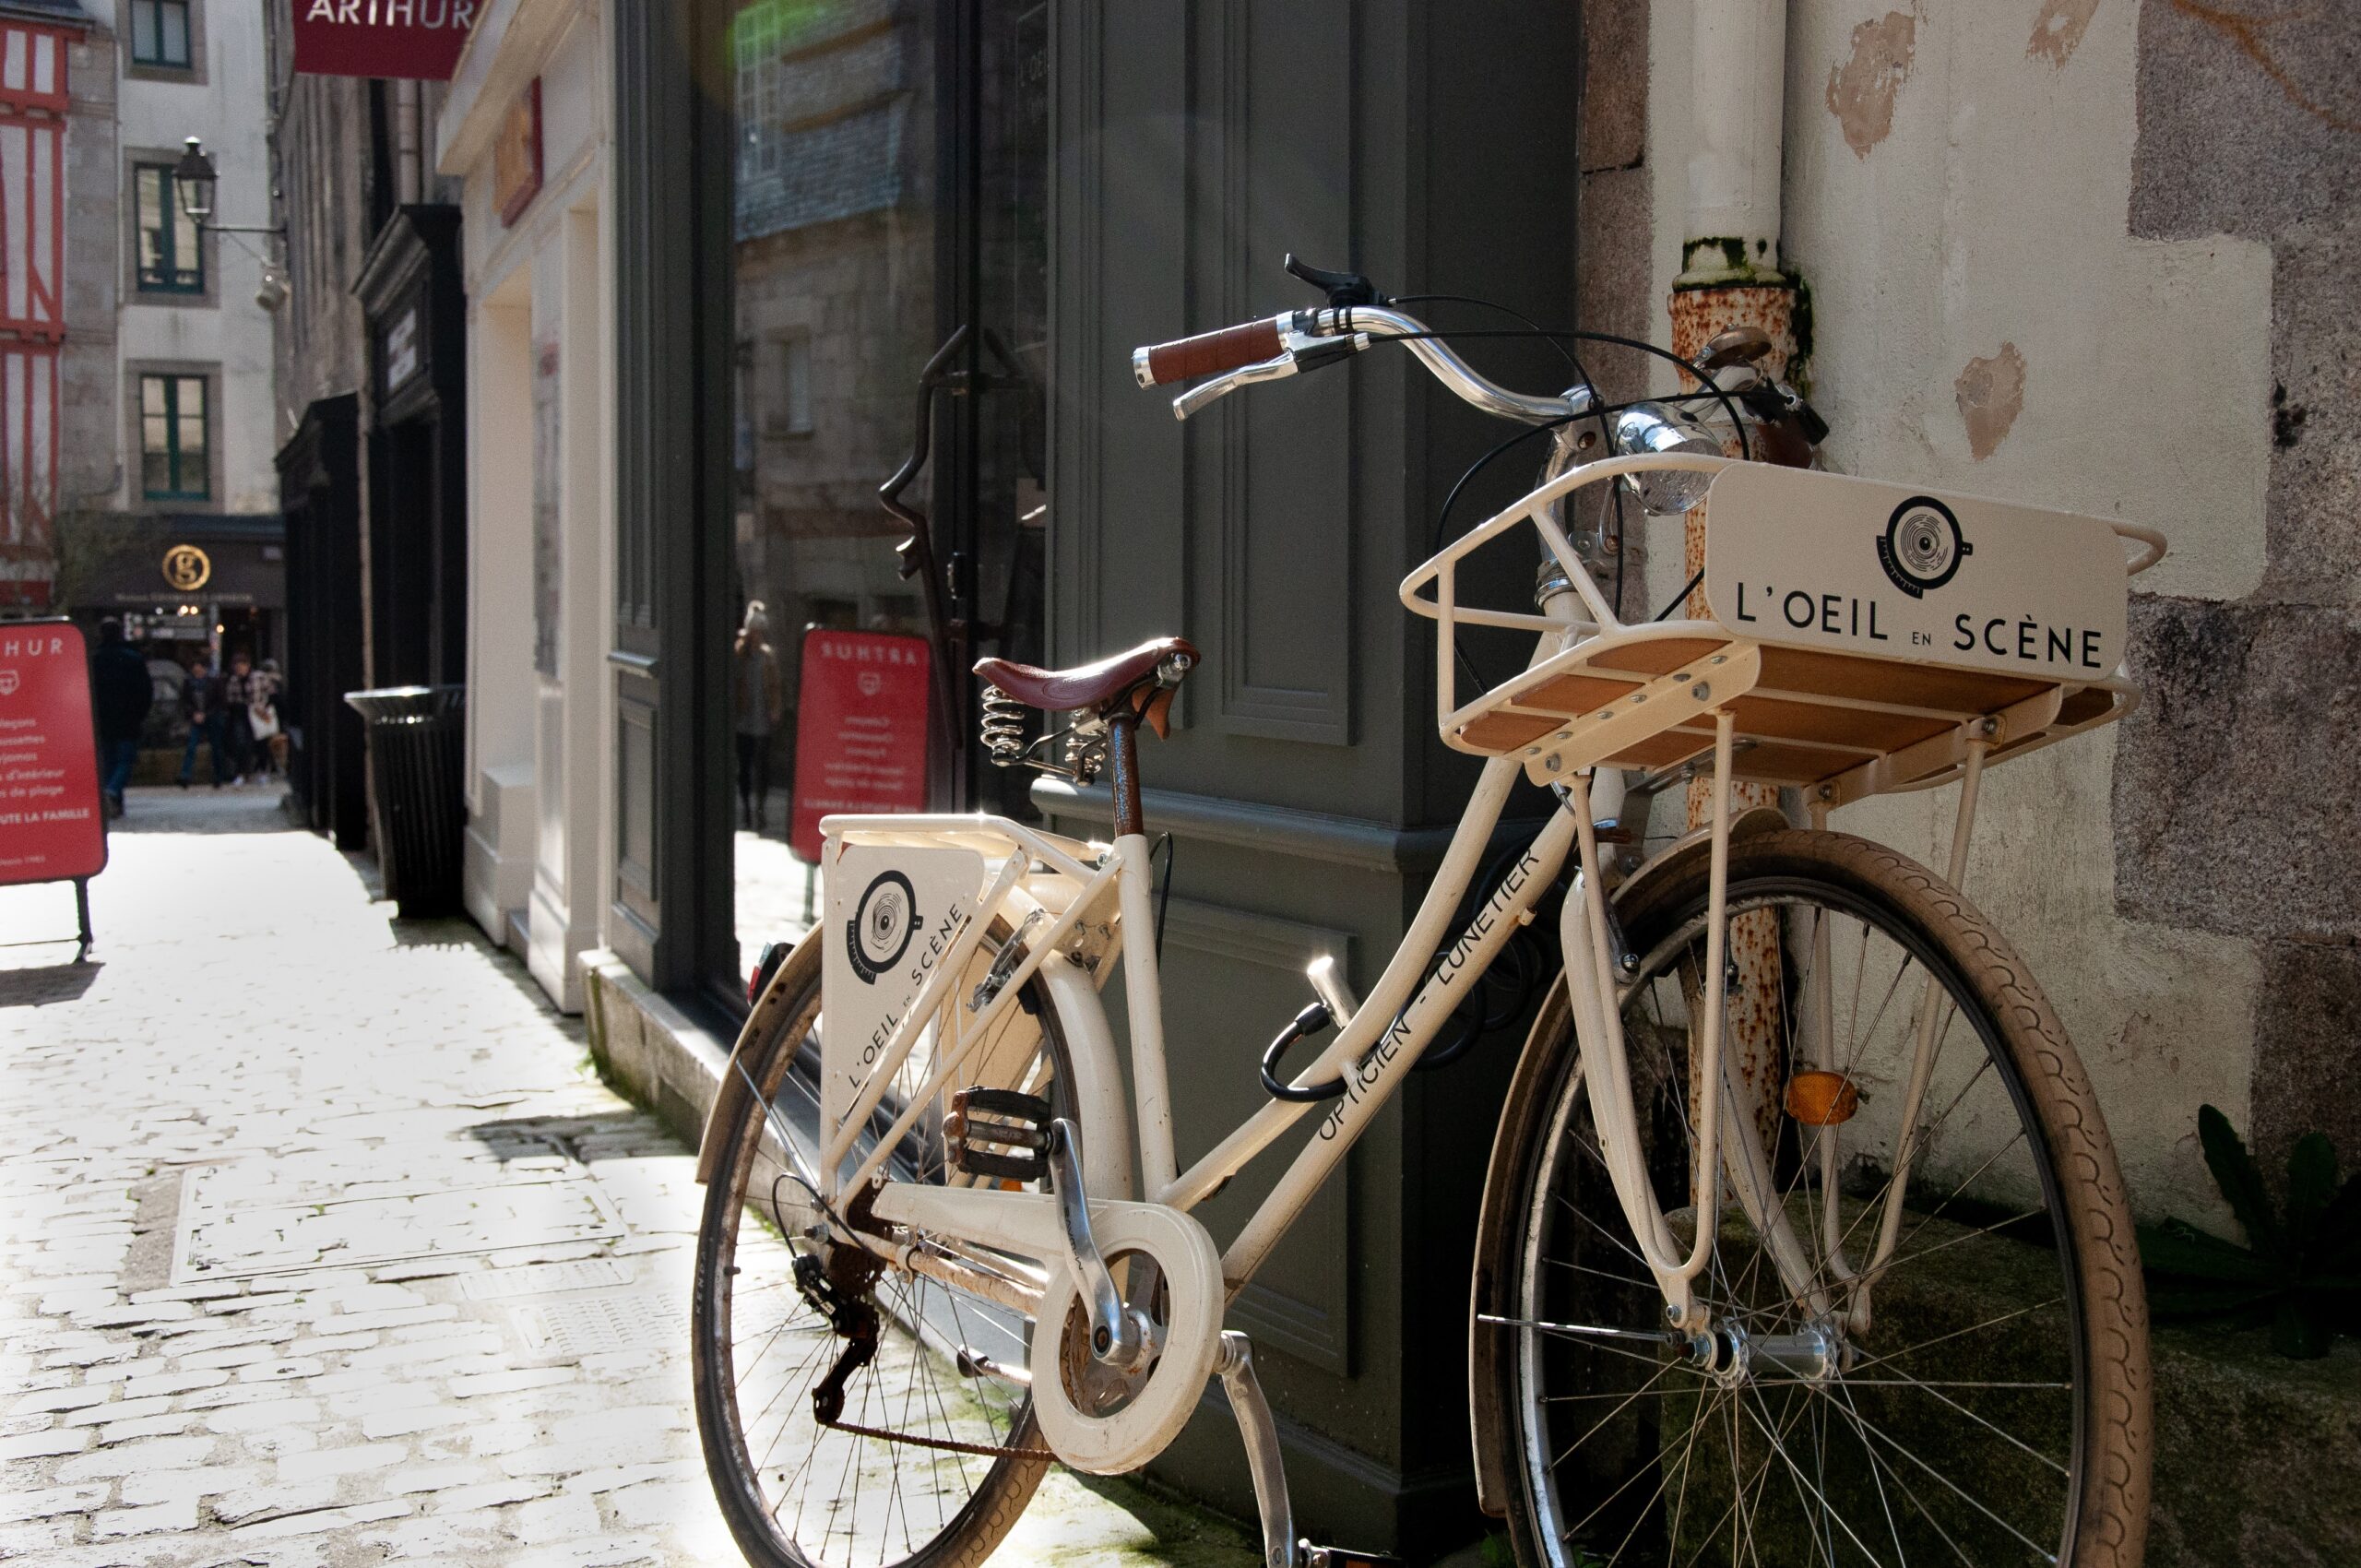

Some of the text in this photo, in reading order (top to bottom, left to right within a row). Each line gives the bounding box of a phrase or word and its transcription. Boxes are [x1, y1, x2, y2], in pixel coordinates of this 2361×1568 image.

[305, 0, 475, 30] ARTHUR
[1738, 582, 2102, 668] L'OEIL EN SCÈNE
[24, 811, 41, 824] LA
[848, 903, 963, 1089] L'OEIL EN SCÈNE
[1319, 1017, 1412, 1141] OPTICIEN
